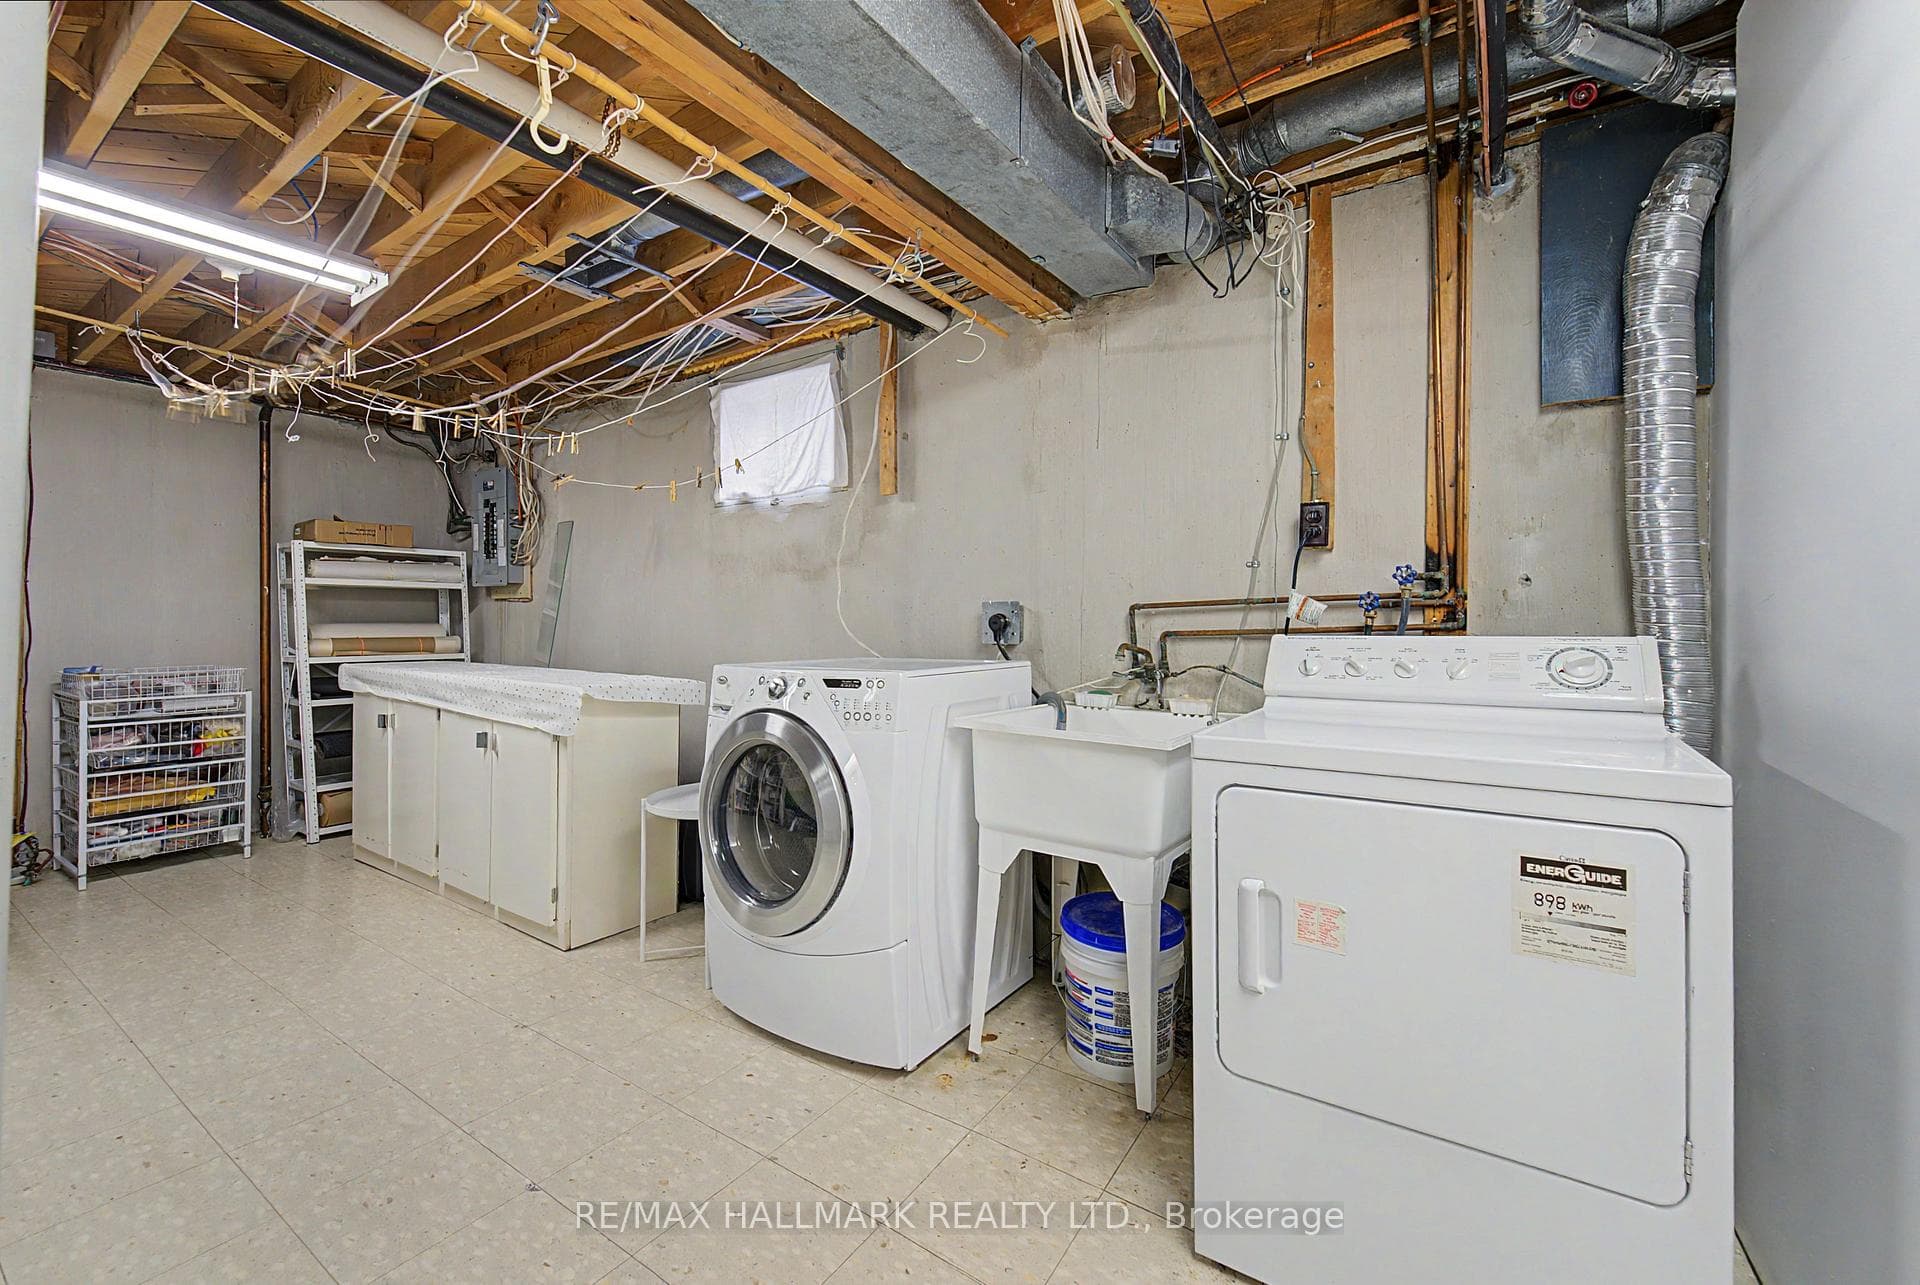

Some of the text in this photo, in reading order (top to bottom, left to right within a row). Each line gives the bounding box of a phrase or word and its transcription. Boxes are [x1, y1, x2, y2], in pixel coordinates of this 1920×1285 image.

[1527, 864, 1622, 885] ENERGUIDE
[1534, 892, 1593, 912] 898 kWh
